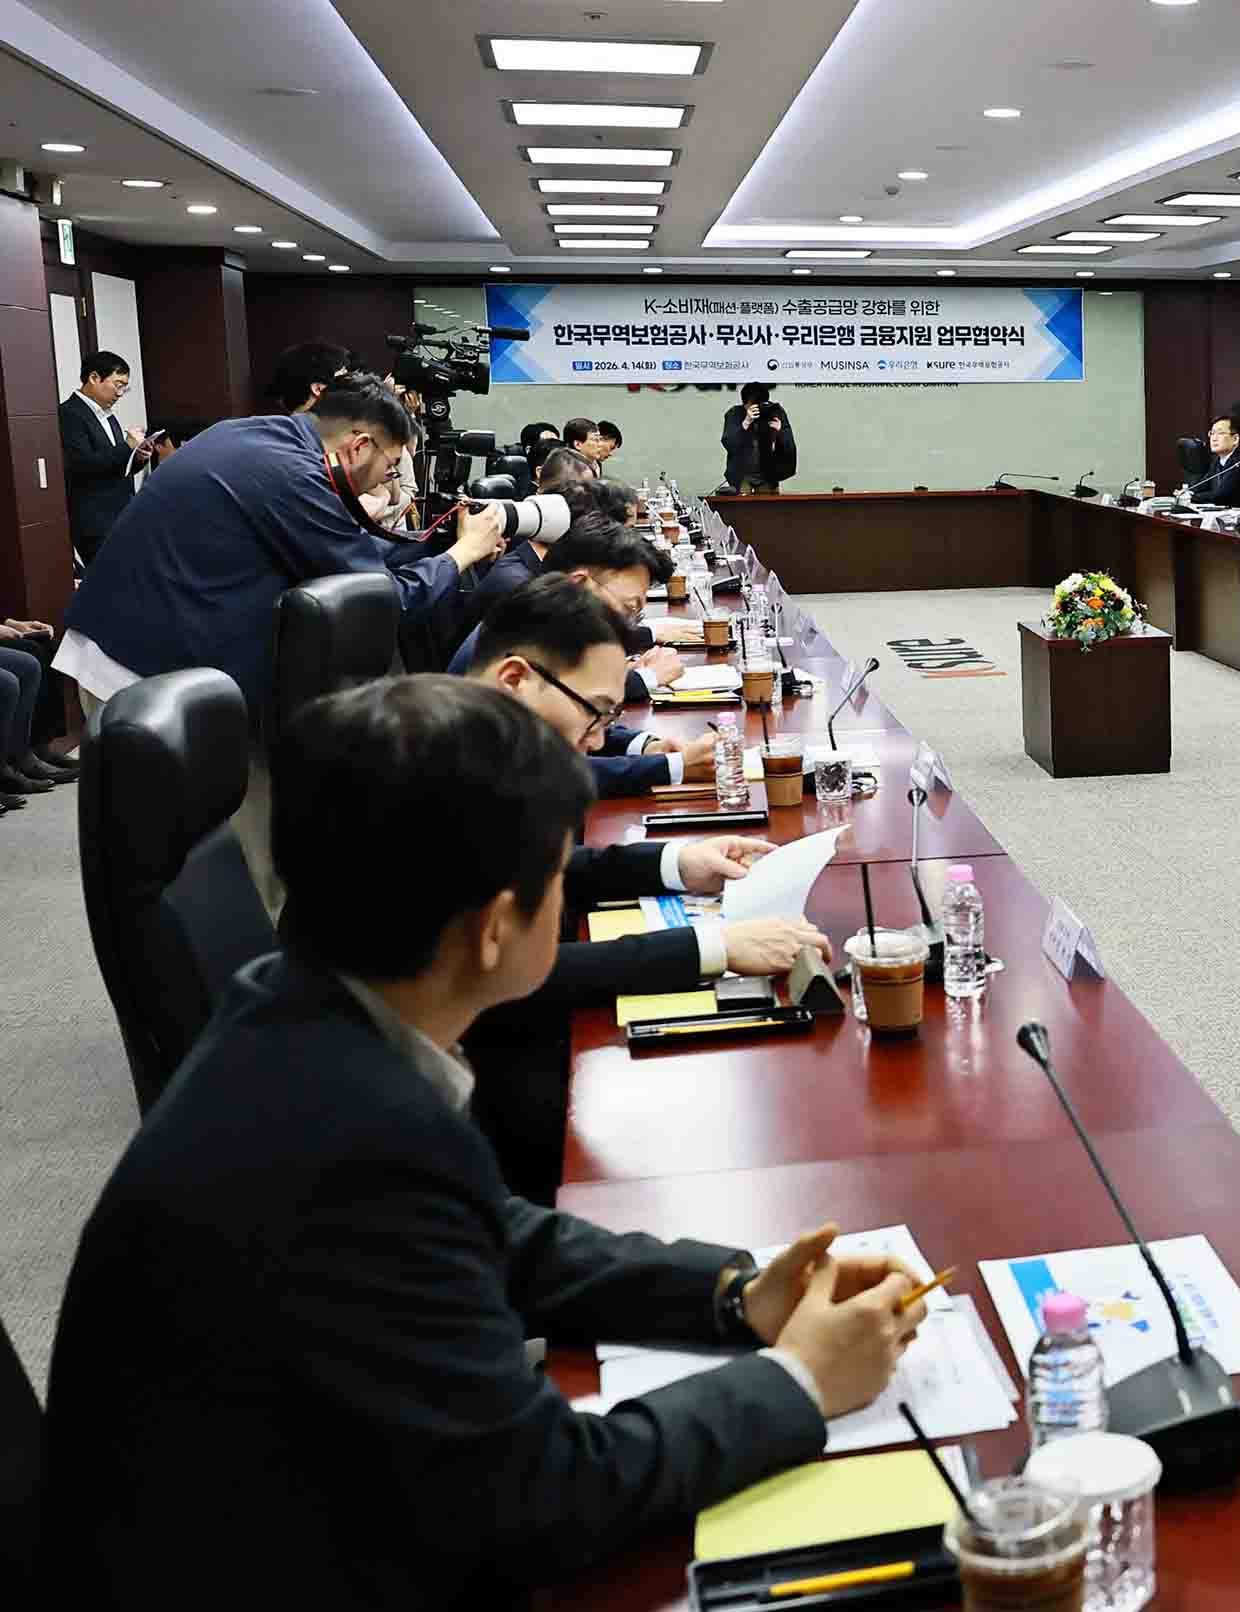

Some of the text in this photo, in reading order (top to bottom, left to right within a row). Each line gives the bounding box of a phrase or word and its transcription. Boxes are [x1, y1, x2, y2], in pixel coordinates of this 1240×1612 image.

[782, 299, 859, 316] 수출공급망
[862, 300, 906, 316] 강화를
[910, 300, 940, 316] 위한
[859, 325, 932, 346] 금융지원
[937, 325, 1025, 347] 업무협약식
[820, 360, 869, 370] MUSINSA
